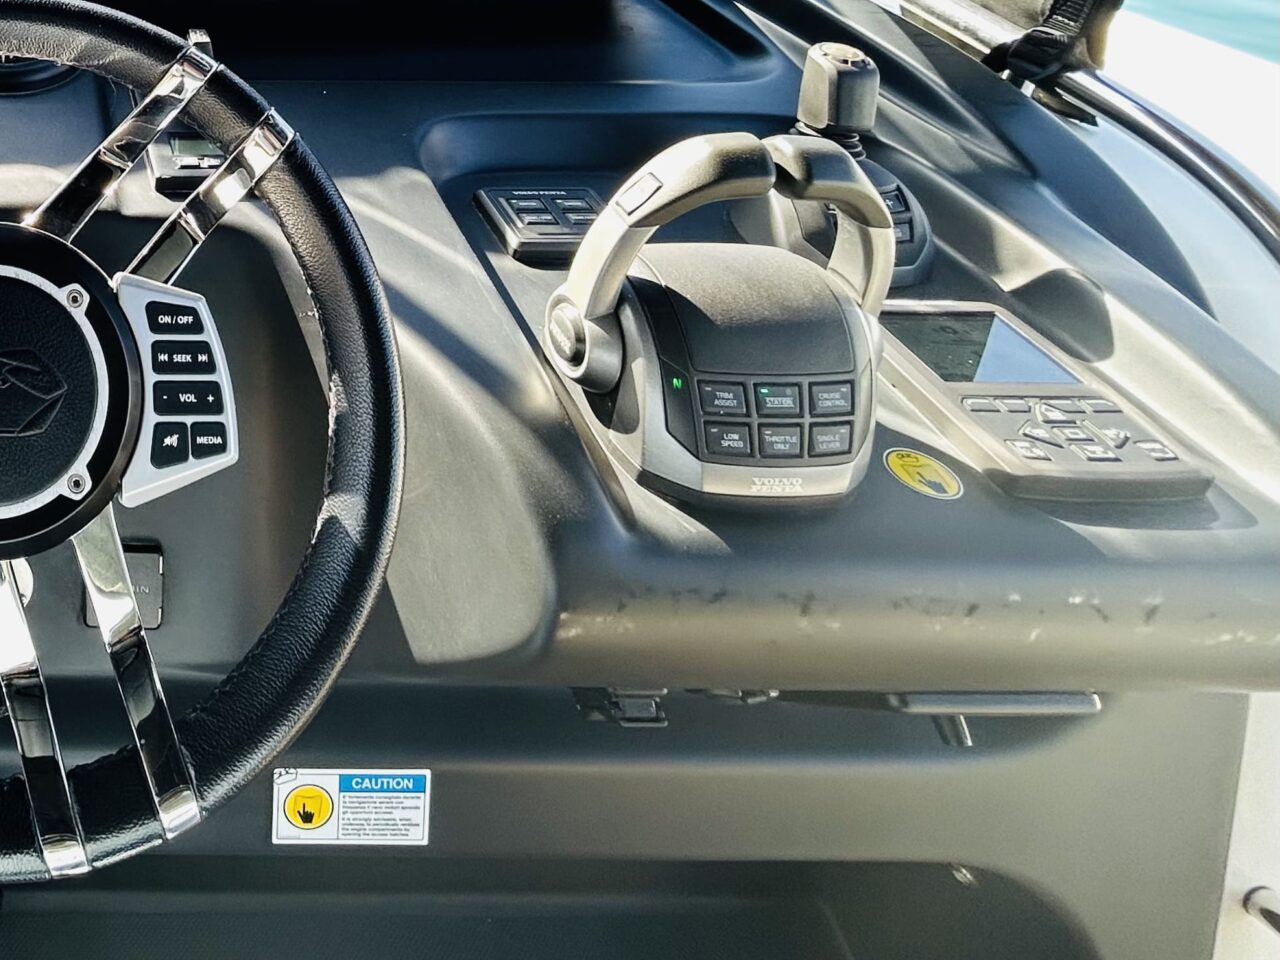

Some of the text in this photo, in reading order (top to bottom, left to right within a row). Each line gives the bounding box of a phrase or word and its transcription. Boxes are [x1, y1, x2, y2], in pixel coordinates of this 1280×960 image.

[158, 315, 171, 324] ON
[178, 316, 193, 324] OFF
[173, 354, 192, 363] SEEK
[673, 378, 682, 389] N
[179, 393, 197, 403] VOL
[196, 435, 223, 445] MEDIA
[721, 440, 744, 448] SPEED
[752, 477, 803, 485] VOLVO
[351, 777, 414, 790] CAUTION
